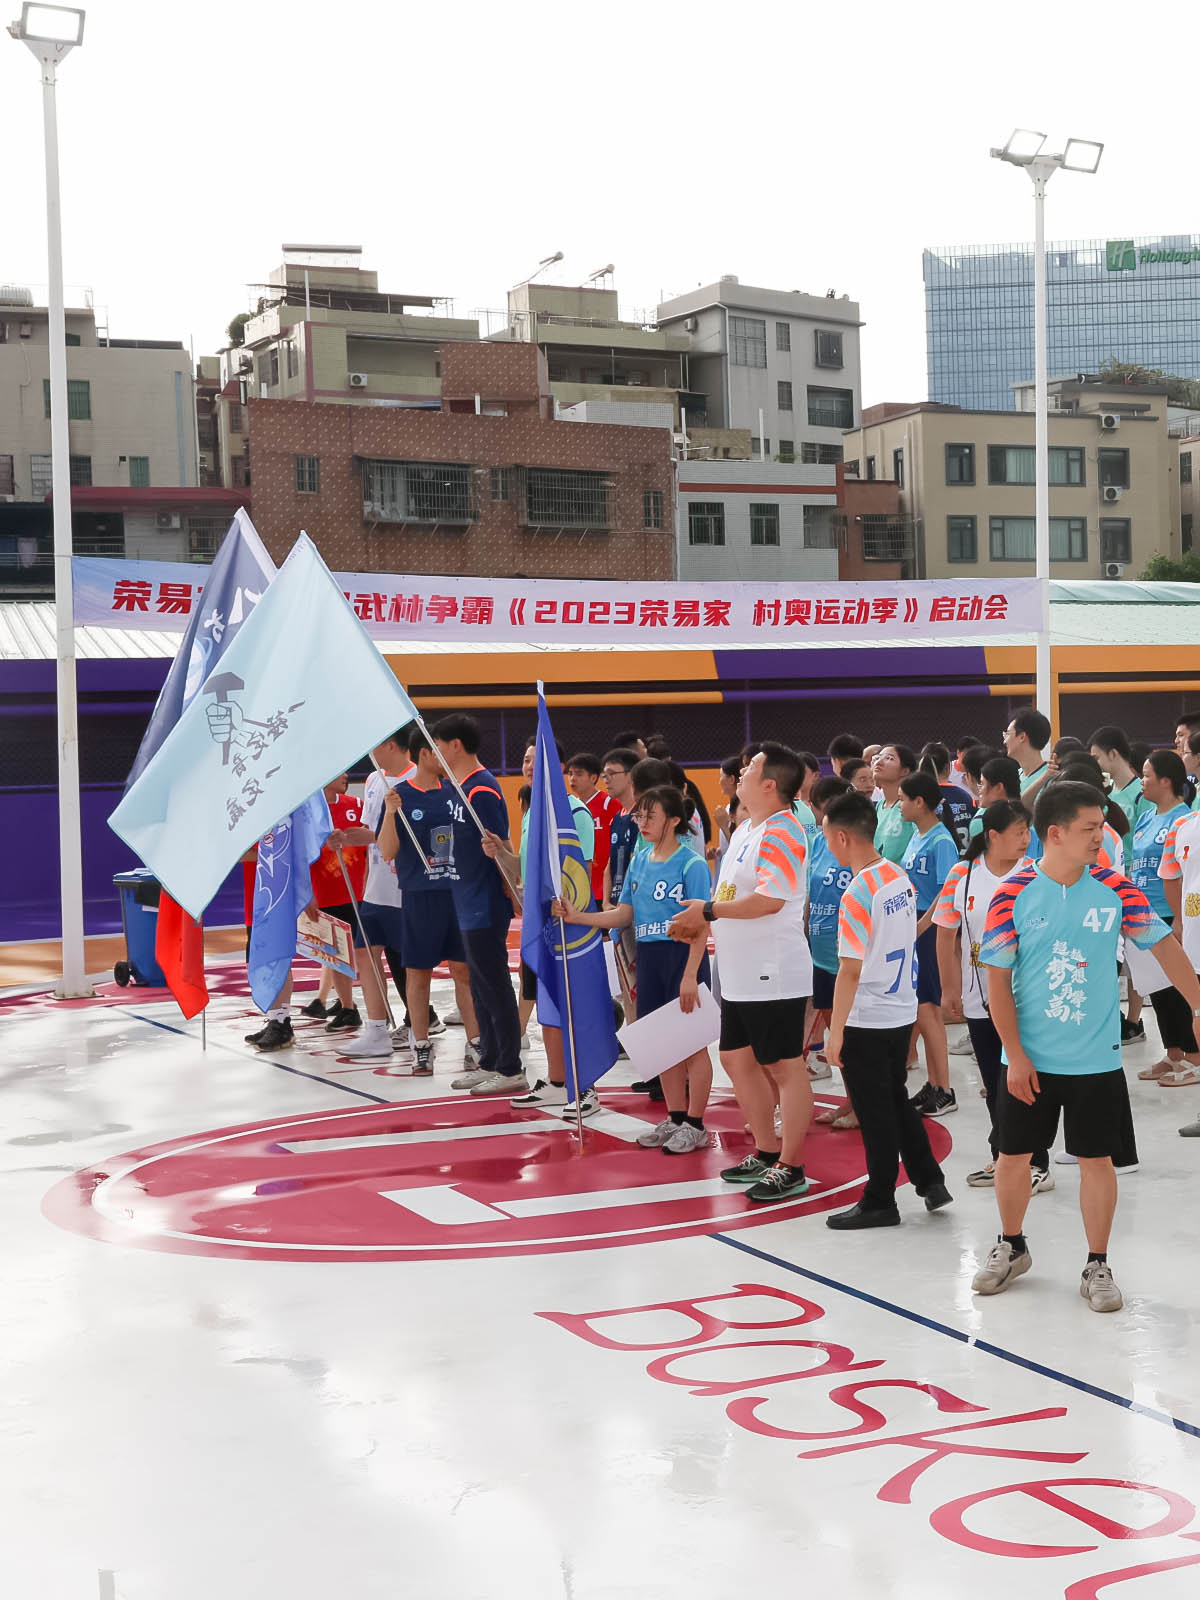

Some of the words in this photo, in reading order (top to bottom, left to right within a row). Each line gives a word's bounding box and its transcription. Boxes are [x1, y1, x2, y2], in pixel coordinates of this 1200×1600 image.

[1139, 248, 1192, 264] Holiday
[112, 579, 203, 614] 荣易
[345, 809, 357, 822] 6
[822, 867, 853, 890] 58
[653, 880, 685, 903] 84
[1082, 907, 1118, 933] 47
